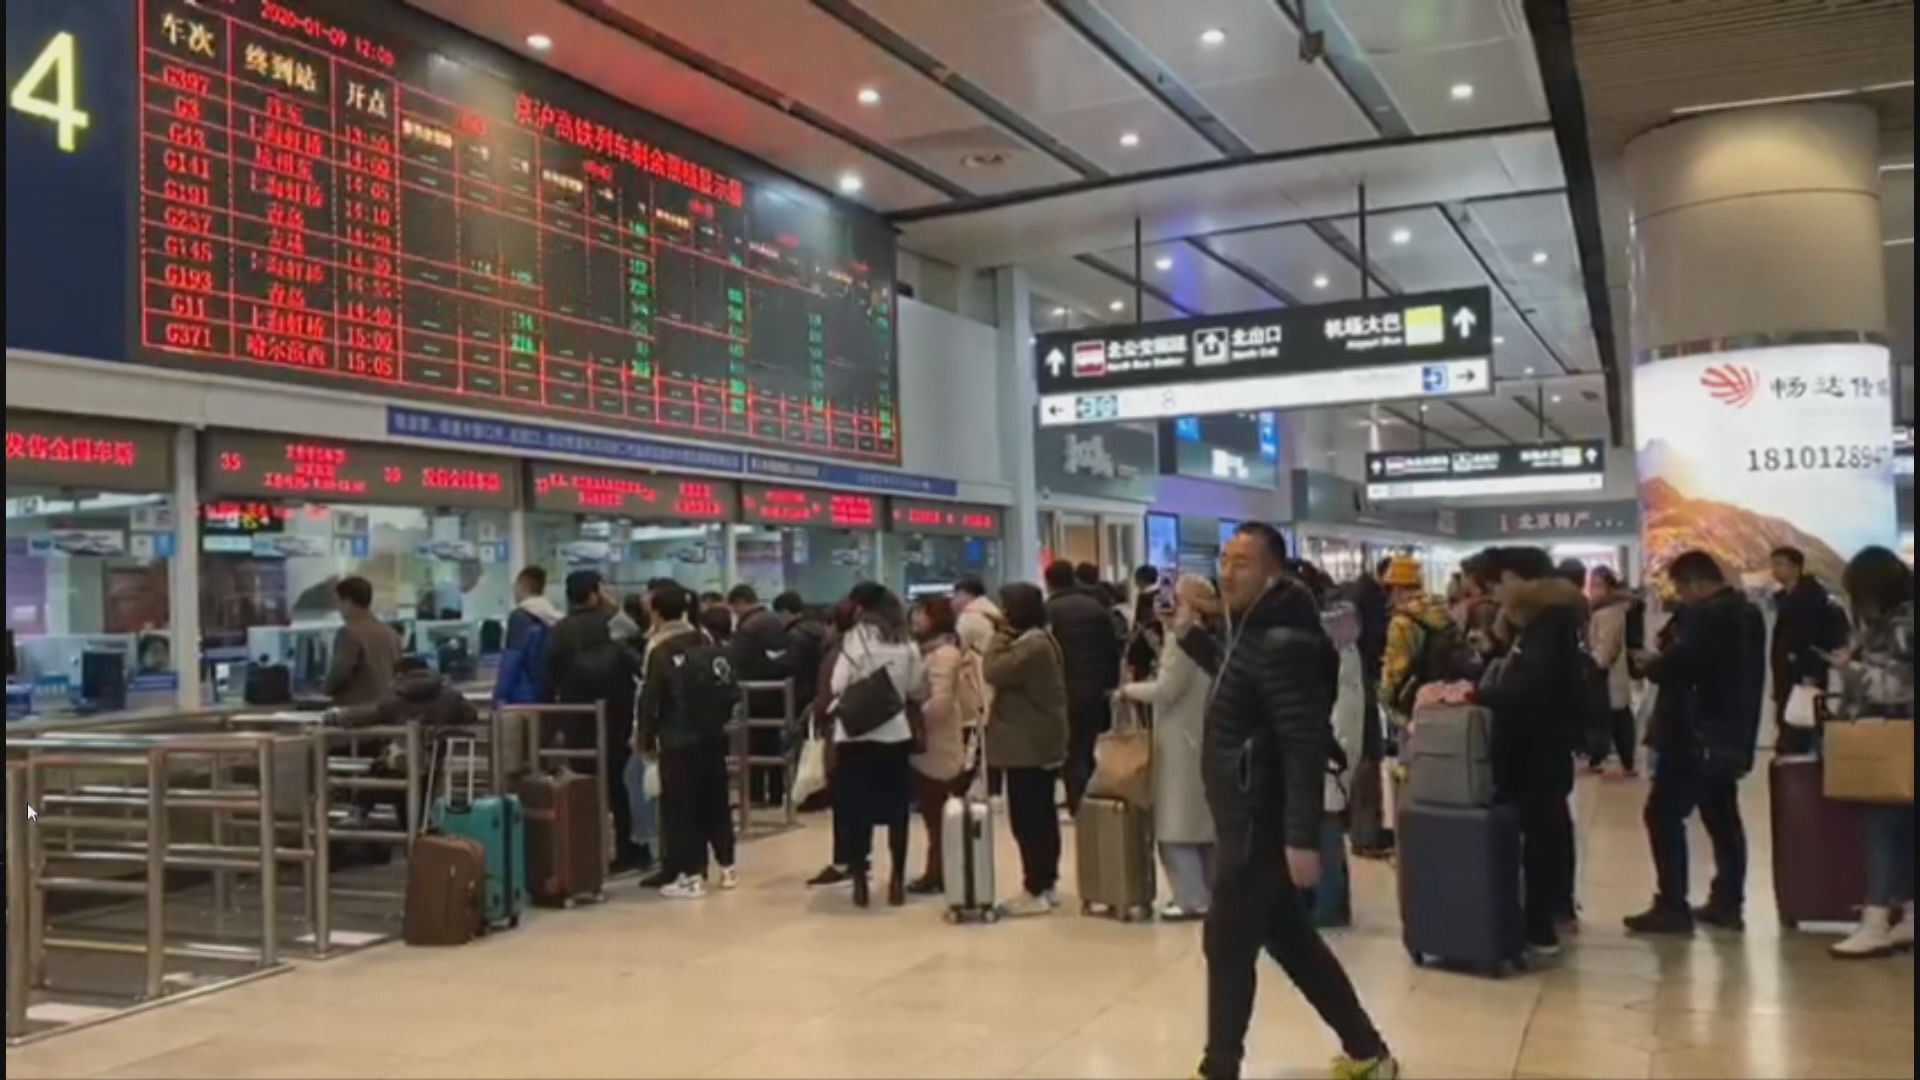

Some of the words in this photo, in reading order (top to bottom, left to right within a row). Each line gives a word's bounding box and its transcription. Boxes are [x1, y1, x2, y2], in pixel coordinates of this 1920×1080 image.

[160, 12, 217, 58] 车次
[262, 2, 348, 47] 2020-01-09
[244, 43, 318, 93] 终到站
[10, 30, 90, 152] 4
[345, 81, 388, 118] 开点
[165, 323, 213, 348] G371
[348, 327, 393, 352] 15:00
[1231, 325, 1282, 347] 北出口
[348, 352, 394, 375] 15:05
